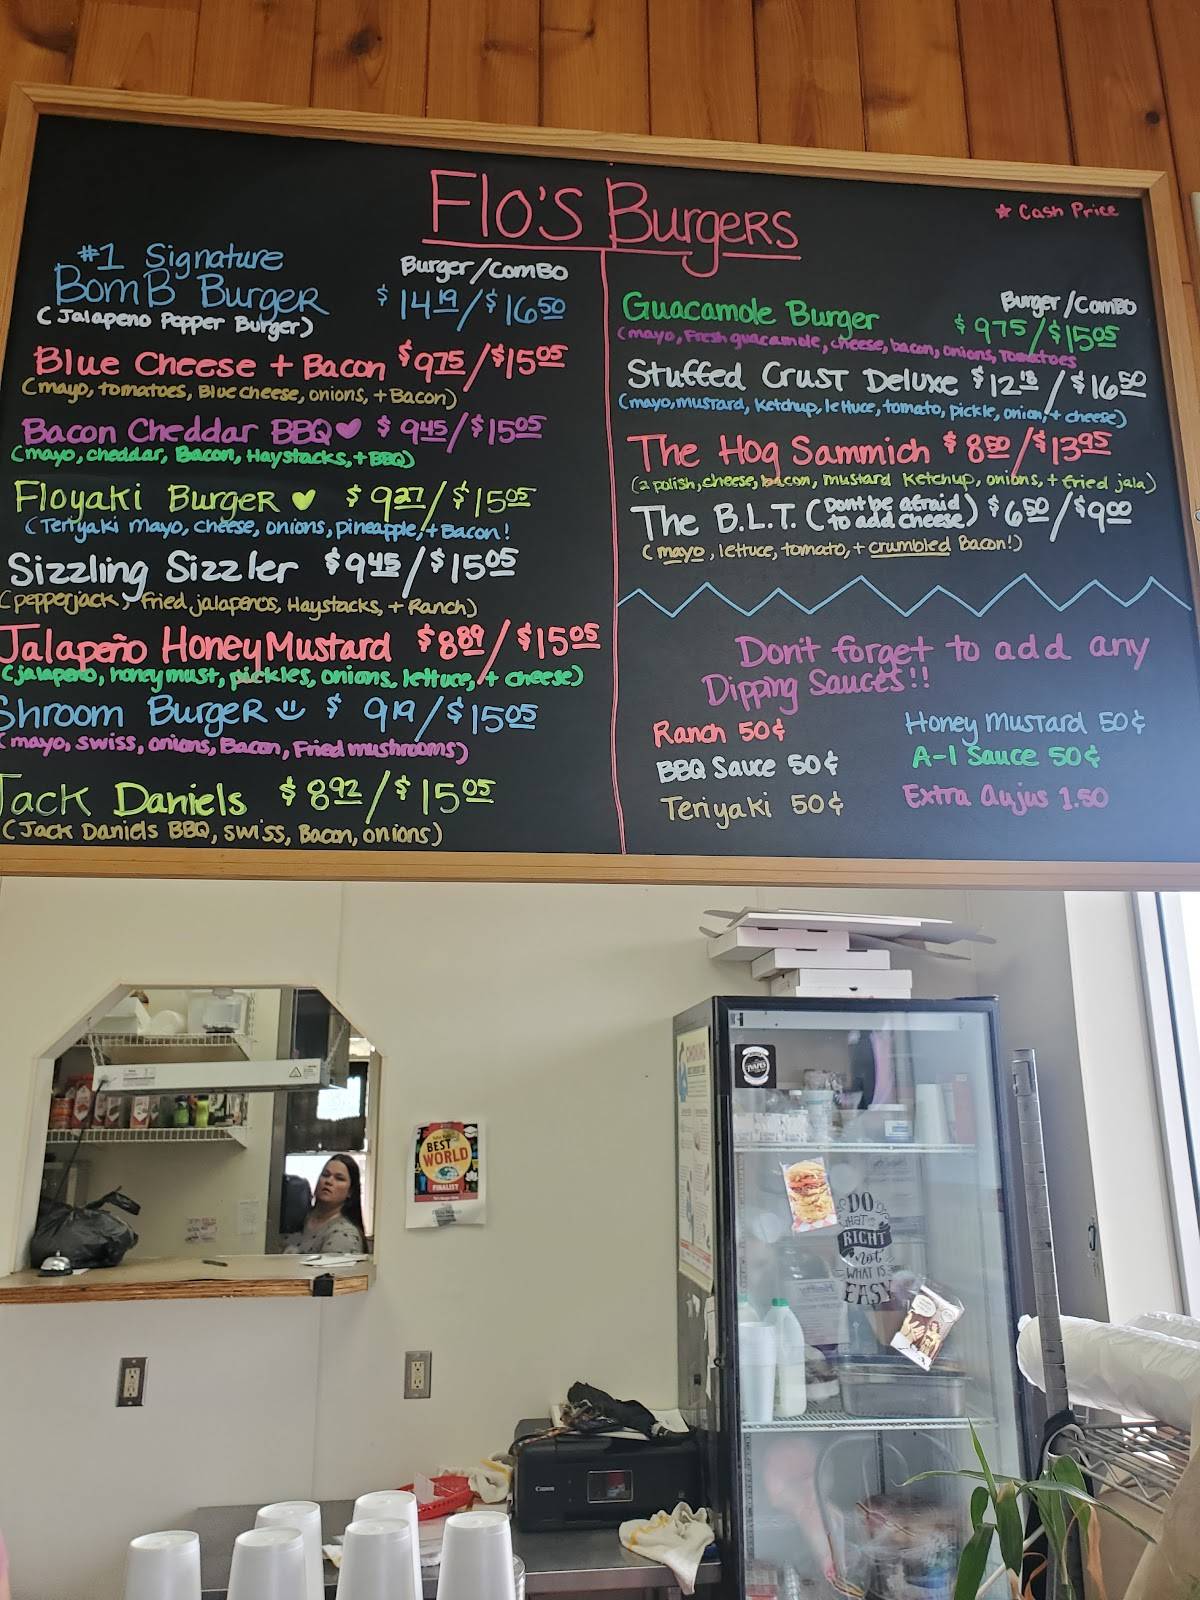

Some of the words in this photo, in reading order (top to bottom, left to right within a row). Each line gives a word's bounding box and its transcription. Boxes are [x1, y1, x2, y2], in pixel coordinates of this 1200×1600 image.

[1019, 202, 1064, 221] Cash
[1071, 201, 1120, 218] Price
[77, 243, 125, 270] #1
[145, 242, 285, 280] Signature
[160, 312, 226, 335] Popper
[622, 291, 777, 326] Guacamole
[785, 299, 880, 340] Burger
[33, 345, 120, 376] Blue
[134, 351, 258, 378] Cheese
[269, 354, 294, 378] +
[302, 353, 386, 381] Bacon
[830, 334, 889, 354] cheese,
[943, 345, 998, 365] onions,
[21, 376, 93, 404] (mayo,
[98, 382, 193, 402] tomatoes,
[309, 388, 369, 405] onions,
[627, 358, 747, 392] Stuffed
[862, 367, 959, 396] Deluxe
[825, 398, 881, 417] lettuce,
[882, 398, 946, 419] tomato,
[949, 403, 1001, 422] pickle,
[22, 416, 117, 446] Bacon
[128, 415, 259, 445] Cheddar
[270, 418, 333, 447] BBQ
[11, 445, 83, 468] (mayo,
[86, 446, 168, 465] cheddar,
[175, 446, 242, 466] Bacon,
[247, 447, 352, 469] Haystacks,
[627, 433, 700, 473] The
[718, 433, 781, 479] Hog
[791, 434, 931, 467] Sammich
[823, 472, 892, 487] mustard
[986, 470, 1043, 487] onions,
[14, 479, 143, 523] Floyaki
[129, 518, 190, 541] mayo,
[194, 517, 260, 539] cheese,
[265, 518, 333, 540] onions,
[630, 504, 700, 542] The
[713, 502, 797, 534] B.L.T.
[868, 494, 893, 511] be
[899, 493, 960, 512] afraid
[827, 513, 851, 531] to
[855, 511, 895, 528] add
[719, 543, 777, 560] lettuce,
[781, 541, 850, 560] tomato,
[870, 536, 951, 554] crumbled
[7, 551, 149, 603] Sizzling
[166, 550, 299, 584] Sizzler
[287, 596, 383, 620] Haystacks,
[832, 634, 934, 673] forget
[945, 634, 981, 662] to
[994, 633, 1072, 661] add
[1089, 634, 1150, 671] any
[321, 664, 398, 689] onions,
[701, 672, 799, 716] Dipping
[0, 694, 124, 732] Shroom
[653, 720, 727, 748] Ranch
[904, 710, 979, 747] Honey
[75, 732, 144, 755] swiss,
[148, 733, 217, 757] onions,
[219, 737, 290, 761] Bacon,
[966, 745, 1040, 767] Sauce
[656, 758, 707, 784] BBQ
[712, 755, 777, 780] Sauce
[113, 781, 248, 817] Daniels
[660, 791, 773, 831] Teriyaki
[902, 783, 972, 809] Extra
[1058, 786, 1110, 812] 1.50
[82, 820, 159, 842] Daniels
[168, 820, 218, 845] BBQ,
[298, 823, 358, 847] Bacon,
[423, 1147, 468, 1167] WORLD
[427, 1139, 451, 1152] BEST
[848, 1192, 873, 1213] DO
[843, 1231, 886, 1247] RIGHT
[847, 1268, 873, 1281] WHAT
[877, 1265, 887, 1278] IS
[844, 1280, 891, 1306] EASY
